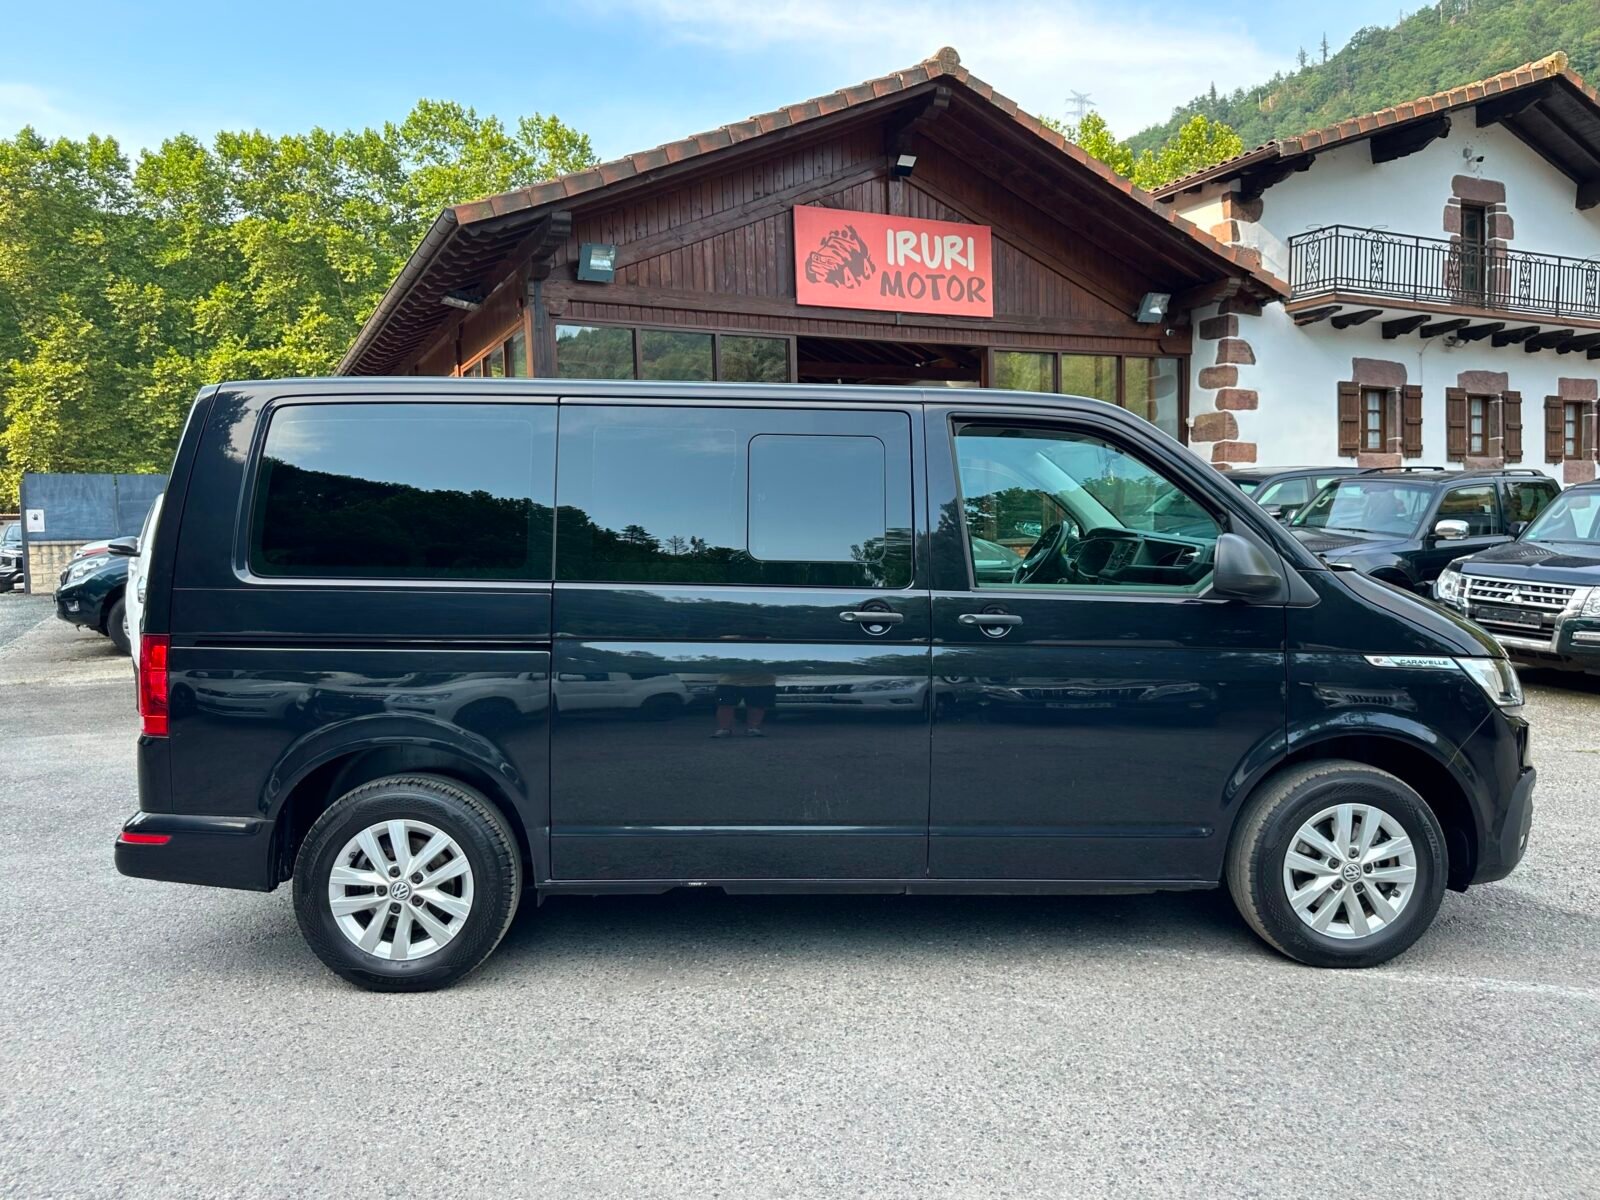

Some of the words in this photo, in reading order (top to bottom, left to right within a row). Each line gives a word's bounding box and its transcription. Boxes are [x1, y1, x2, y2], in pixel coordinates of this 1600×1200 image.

[886, 229, 975, 272] IRURI
[880, 271, 986, 303] MOTOR
[1400, 658, 1449, 666] CARAVELLE
